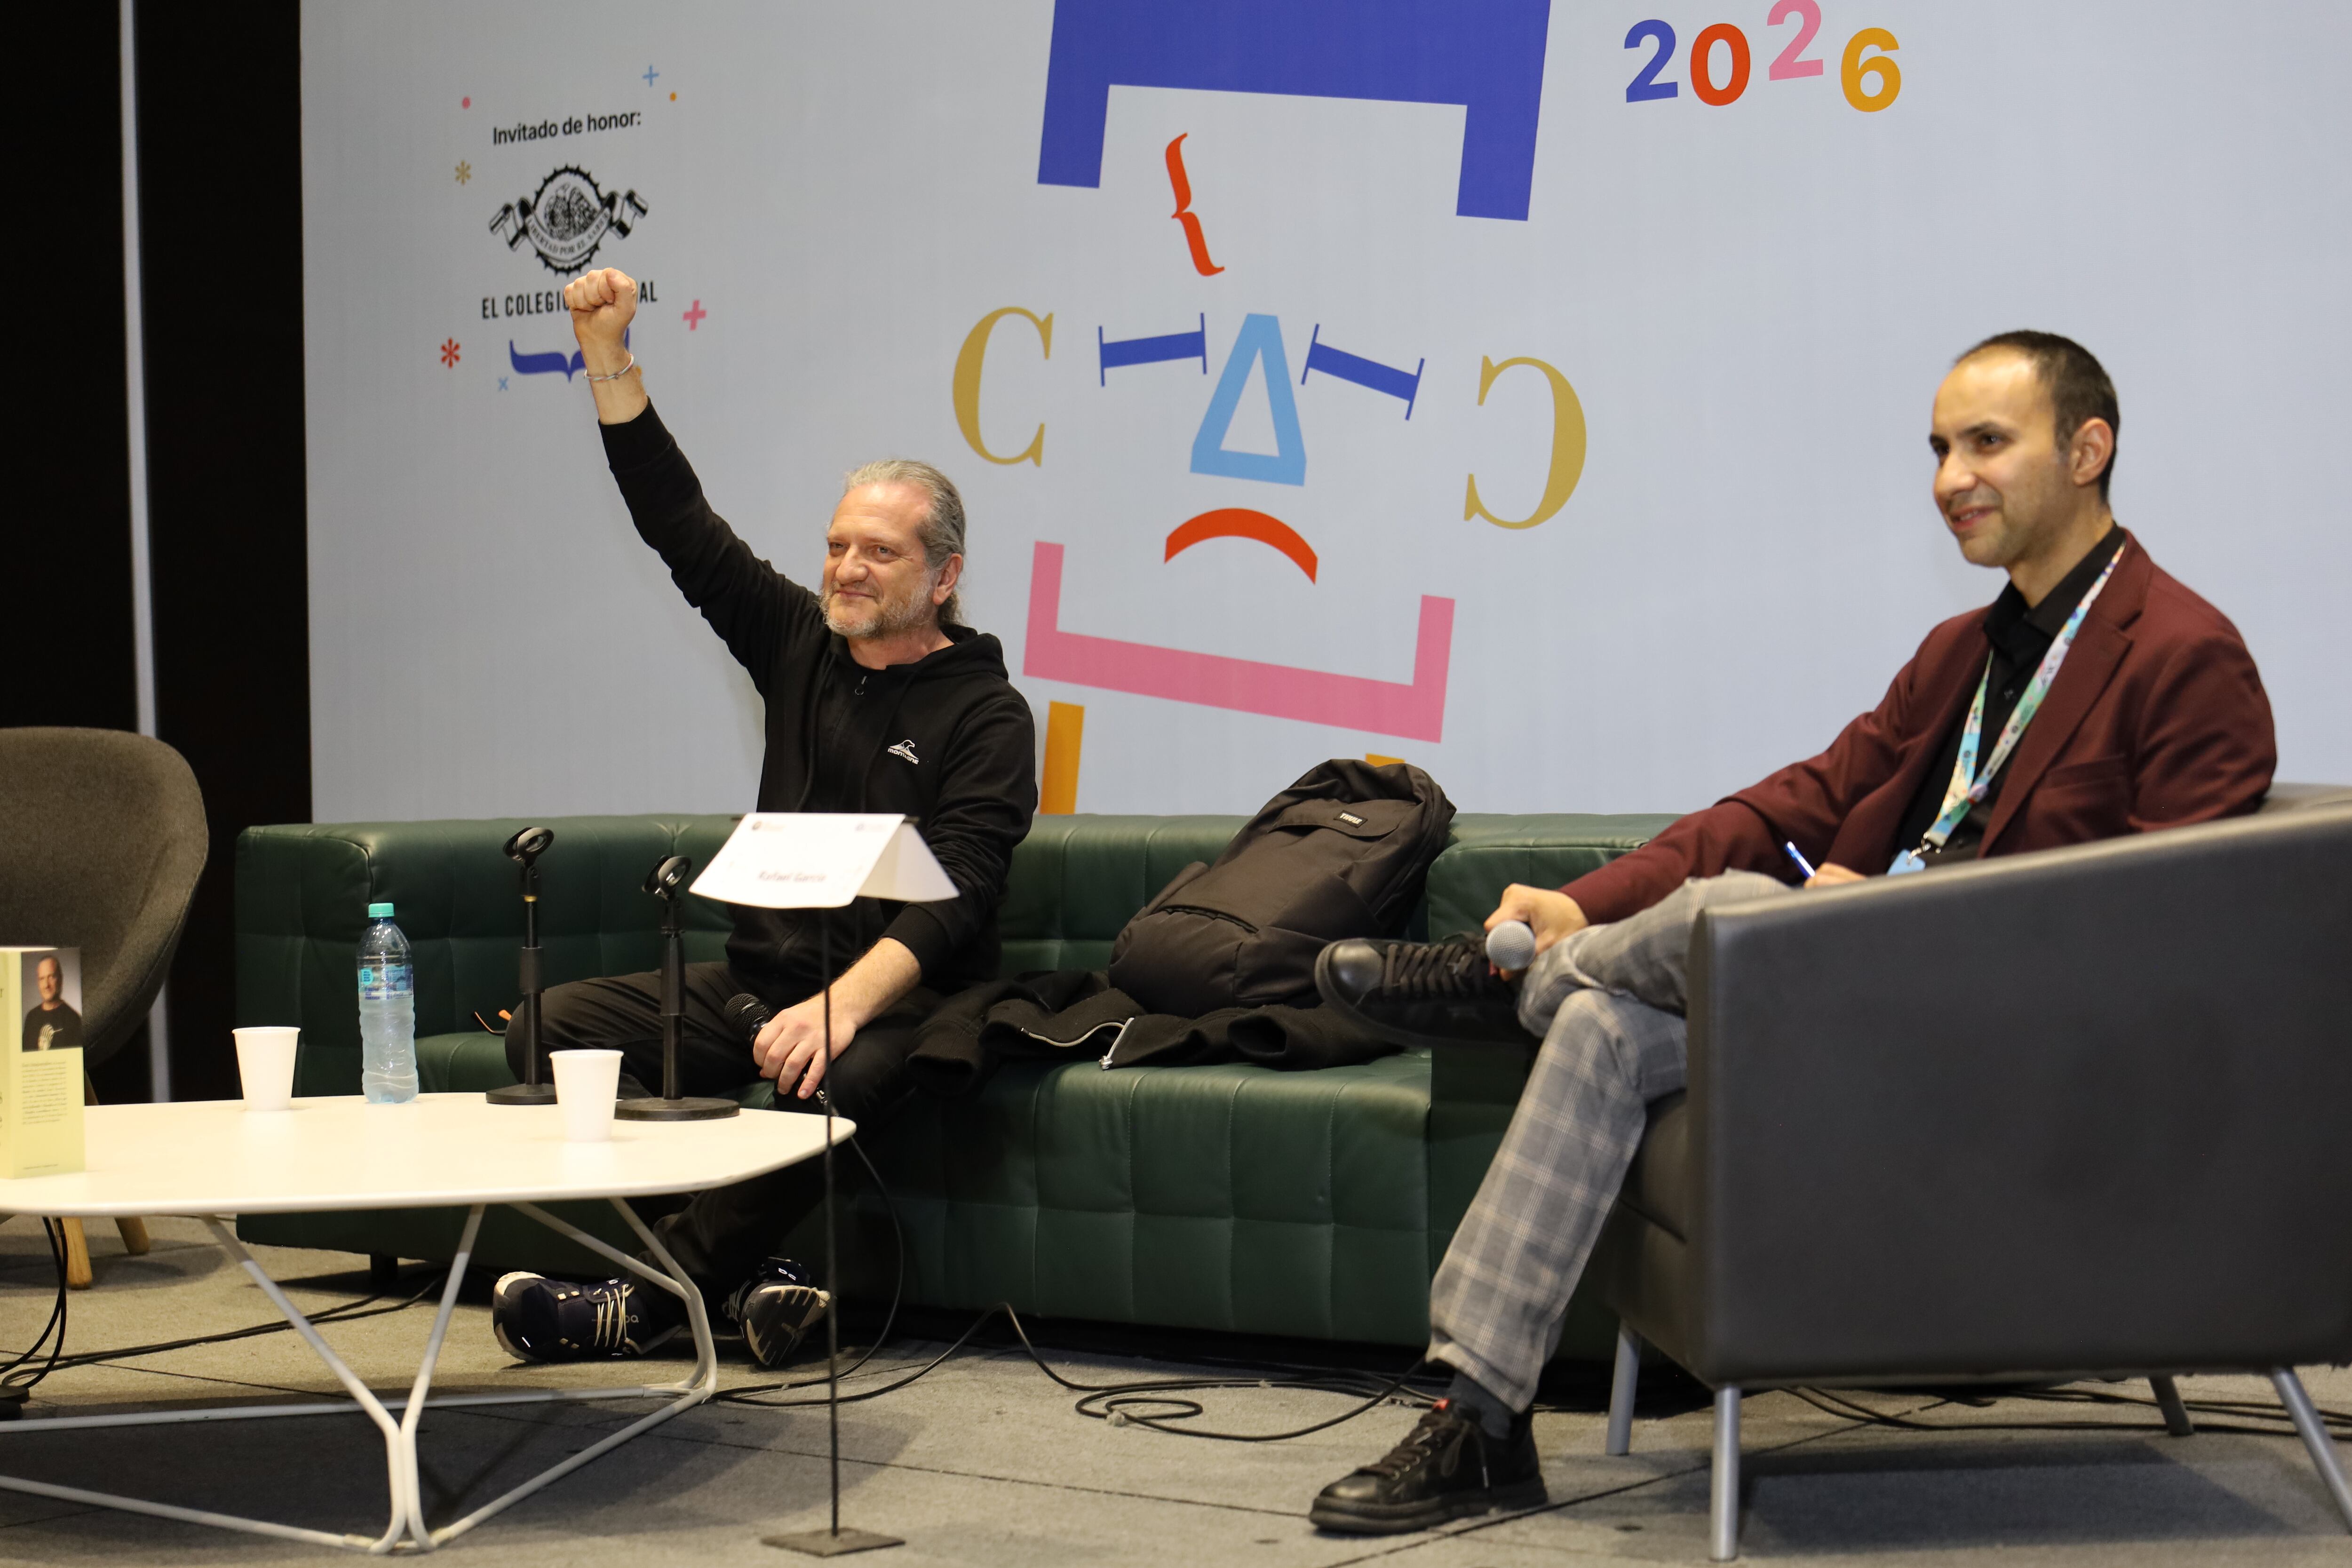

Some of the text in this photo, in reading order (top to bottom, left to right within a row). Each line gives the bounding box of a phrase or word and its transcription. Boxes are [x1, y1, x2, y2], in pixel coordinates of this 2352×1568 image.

[1624, 0, 1901, 112] 2026
[493, 111, 641, 145] Invitado de honor:
[482, 297, 499, 319] EL
[1339, 812, 1363, 825] THULE
